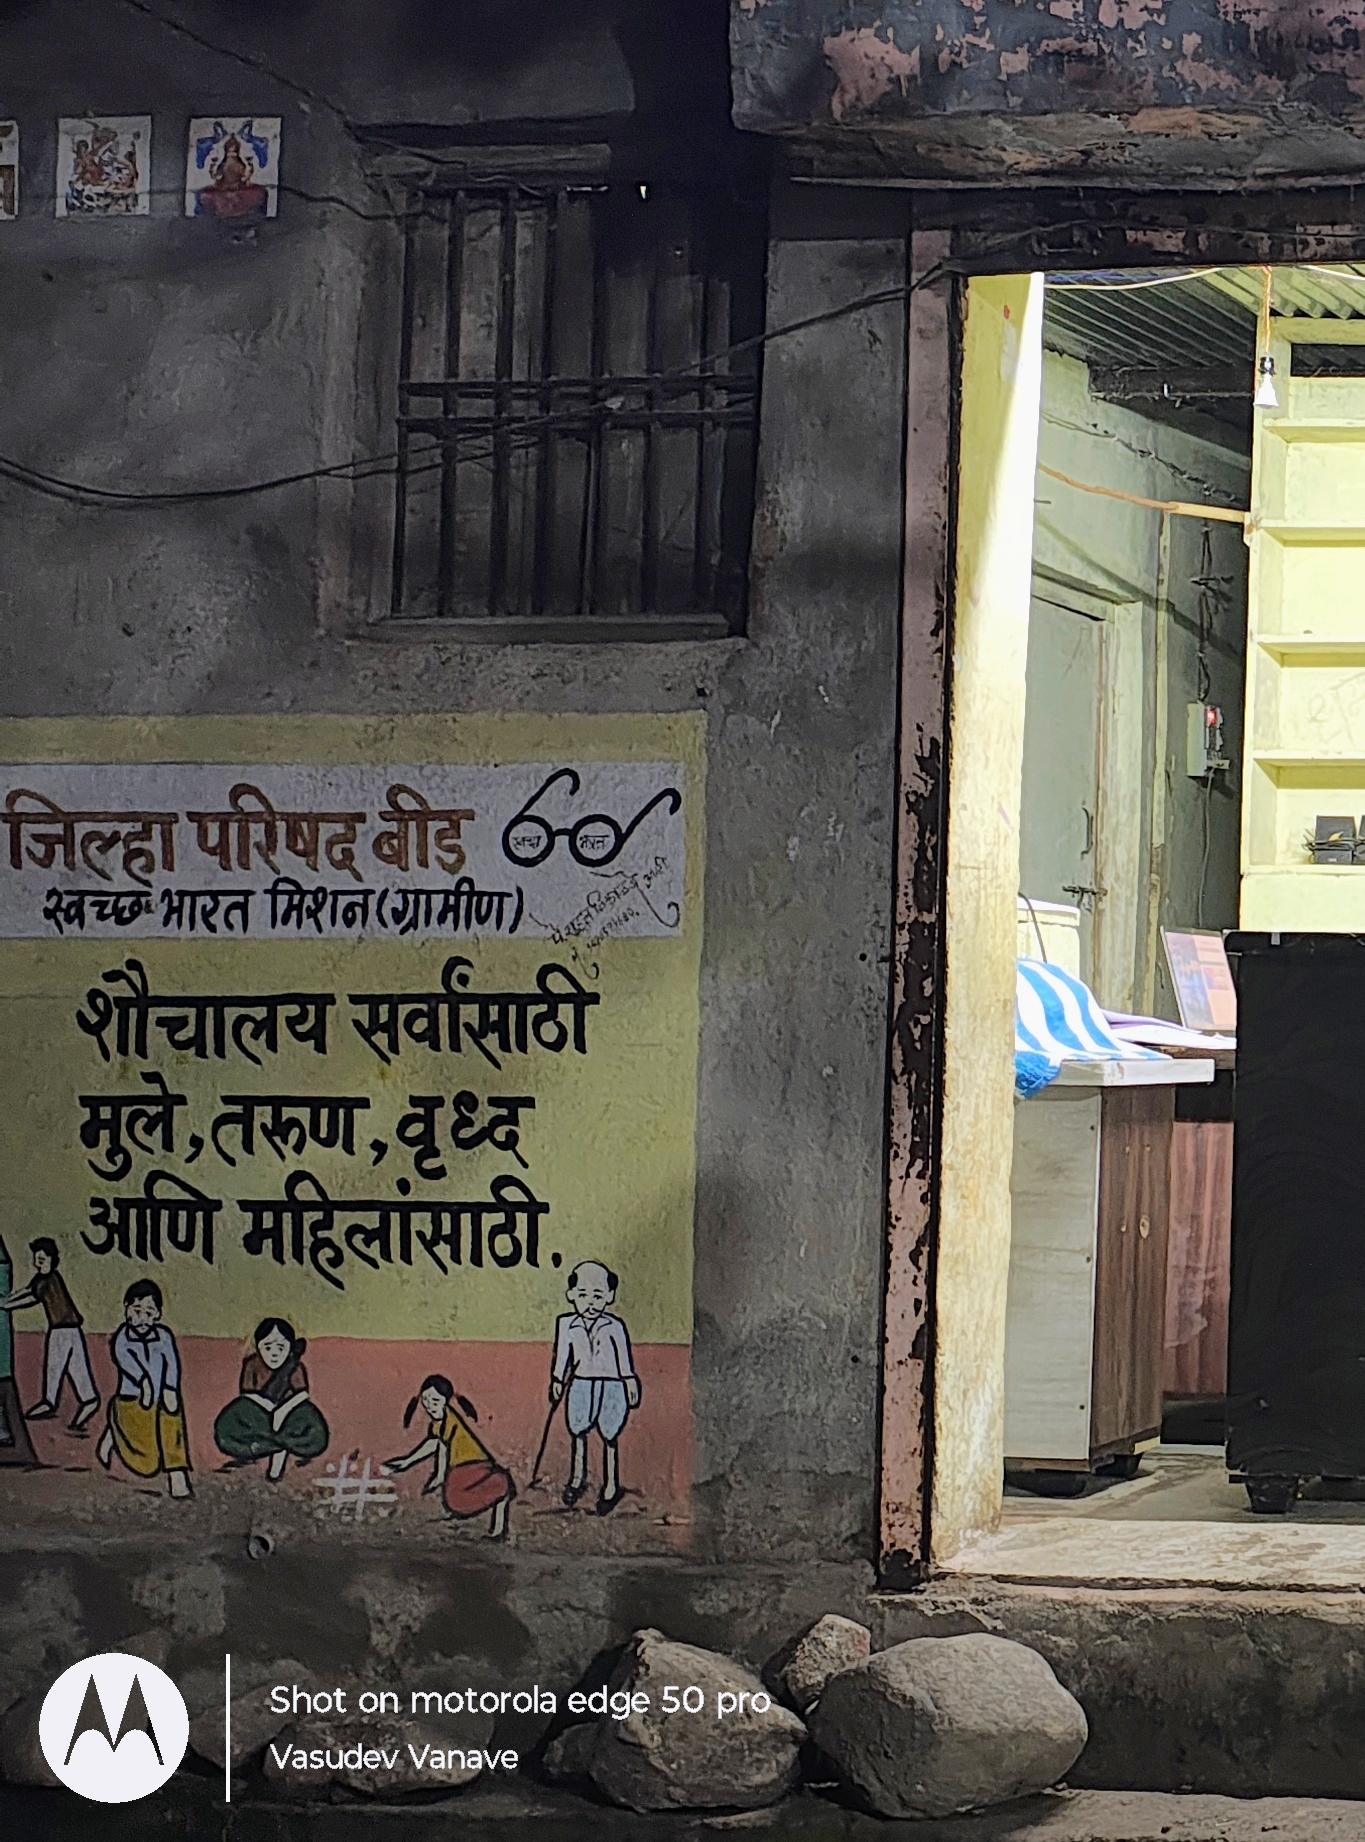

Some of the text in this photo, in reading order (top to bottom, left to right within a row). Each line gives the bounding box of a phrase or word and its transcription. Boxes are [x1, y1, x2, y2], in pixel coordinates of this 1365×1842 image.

[2, 783, 475, 887] जिल्हा परिषद बीड
[159, 888, 252, 935] भारत
[76, 956, 601, 1071] शौचालय सर्वांसाठी
[79, 1169, 224, 1267] आणि
